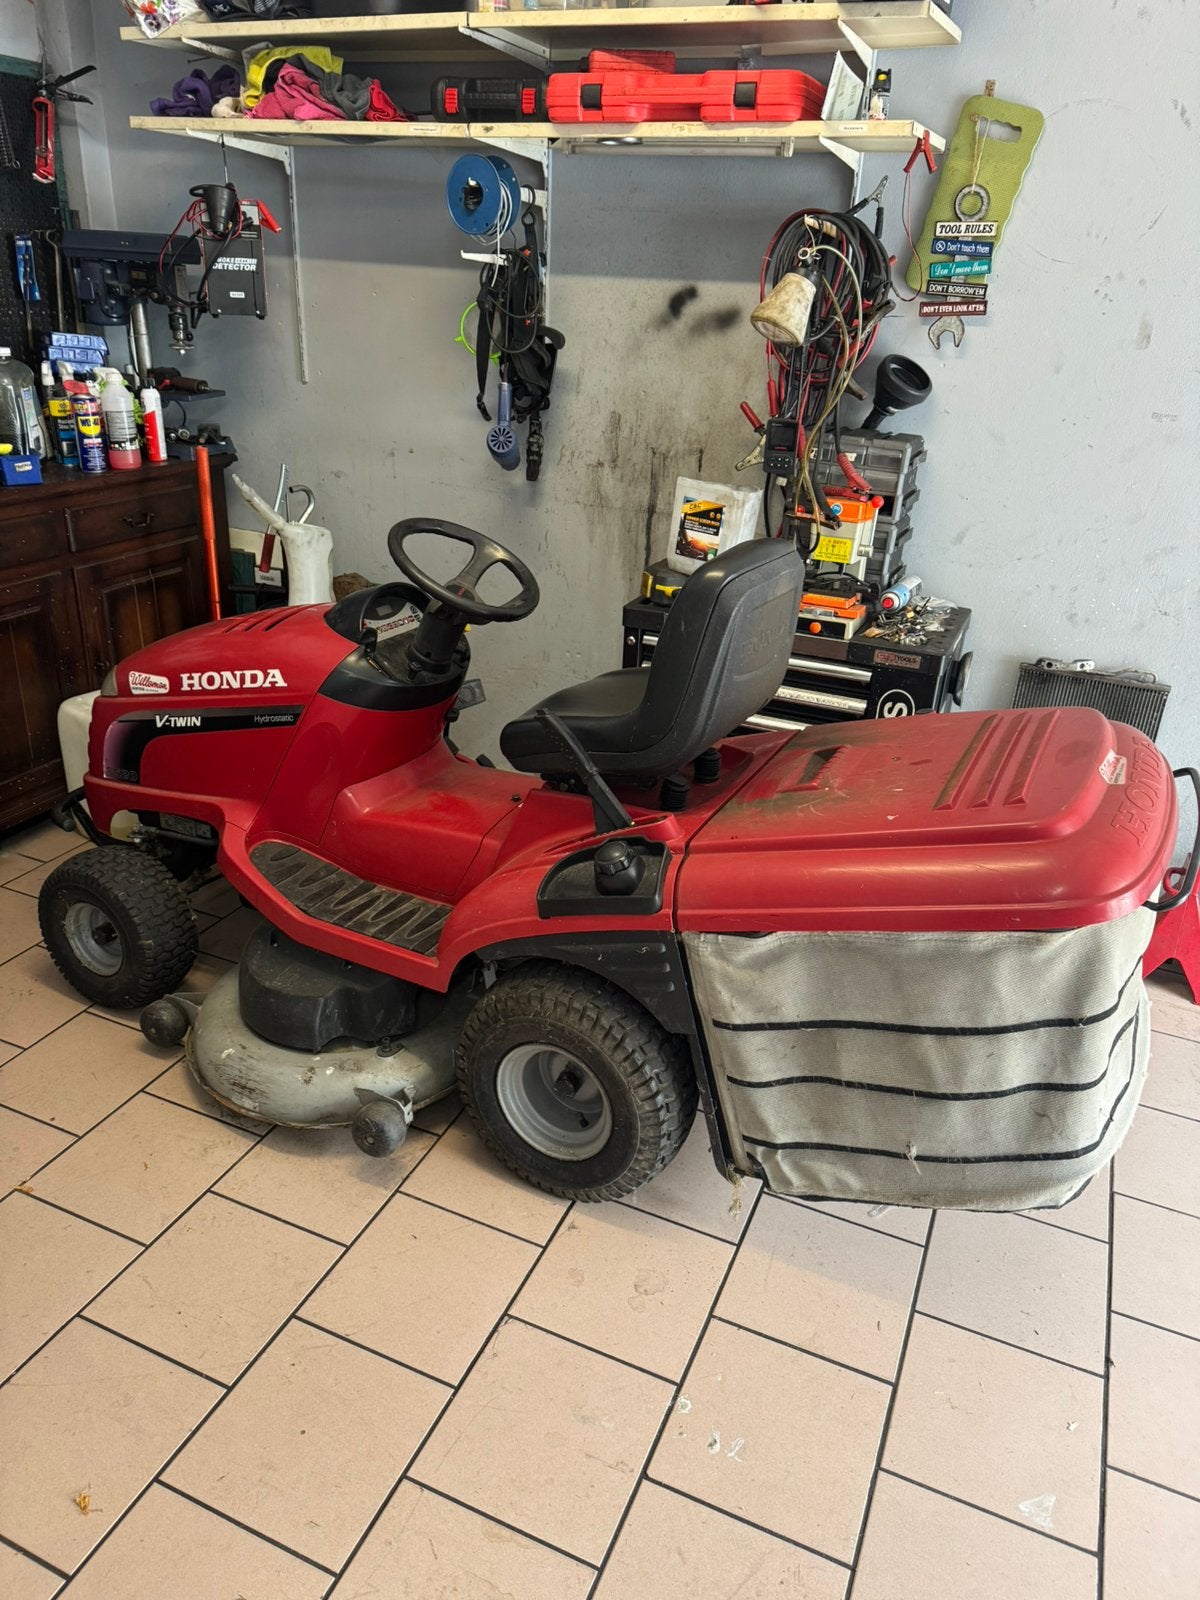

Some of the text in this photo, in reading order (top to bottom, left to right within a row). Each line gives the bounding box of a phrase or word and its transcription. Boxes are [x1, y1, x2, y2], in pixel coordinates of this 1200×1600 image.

[939, 224, 994, 234] TOOL RULES
[946, 242, 990, 253] Don't touch them
[212, 263, 257, 271] DETECTOR
[929, 284, 946, 292] DON'T
[180, 669, 288, 691] HONDA
[155, 714, 202, 728] V-TWIN
[254, 714, 294, 724] Hydrostatic
